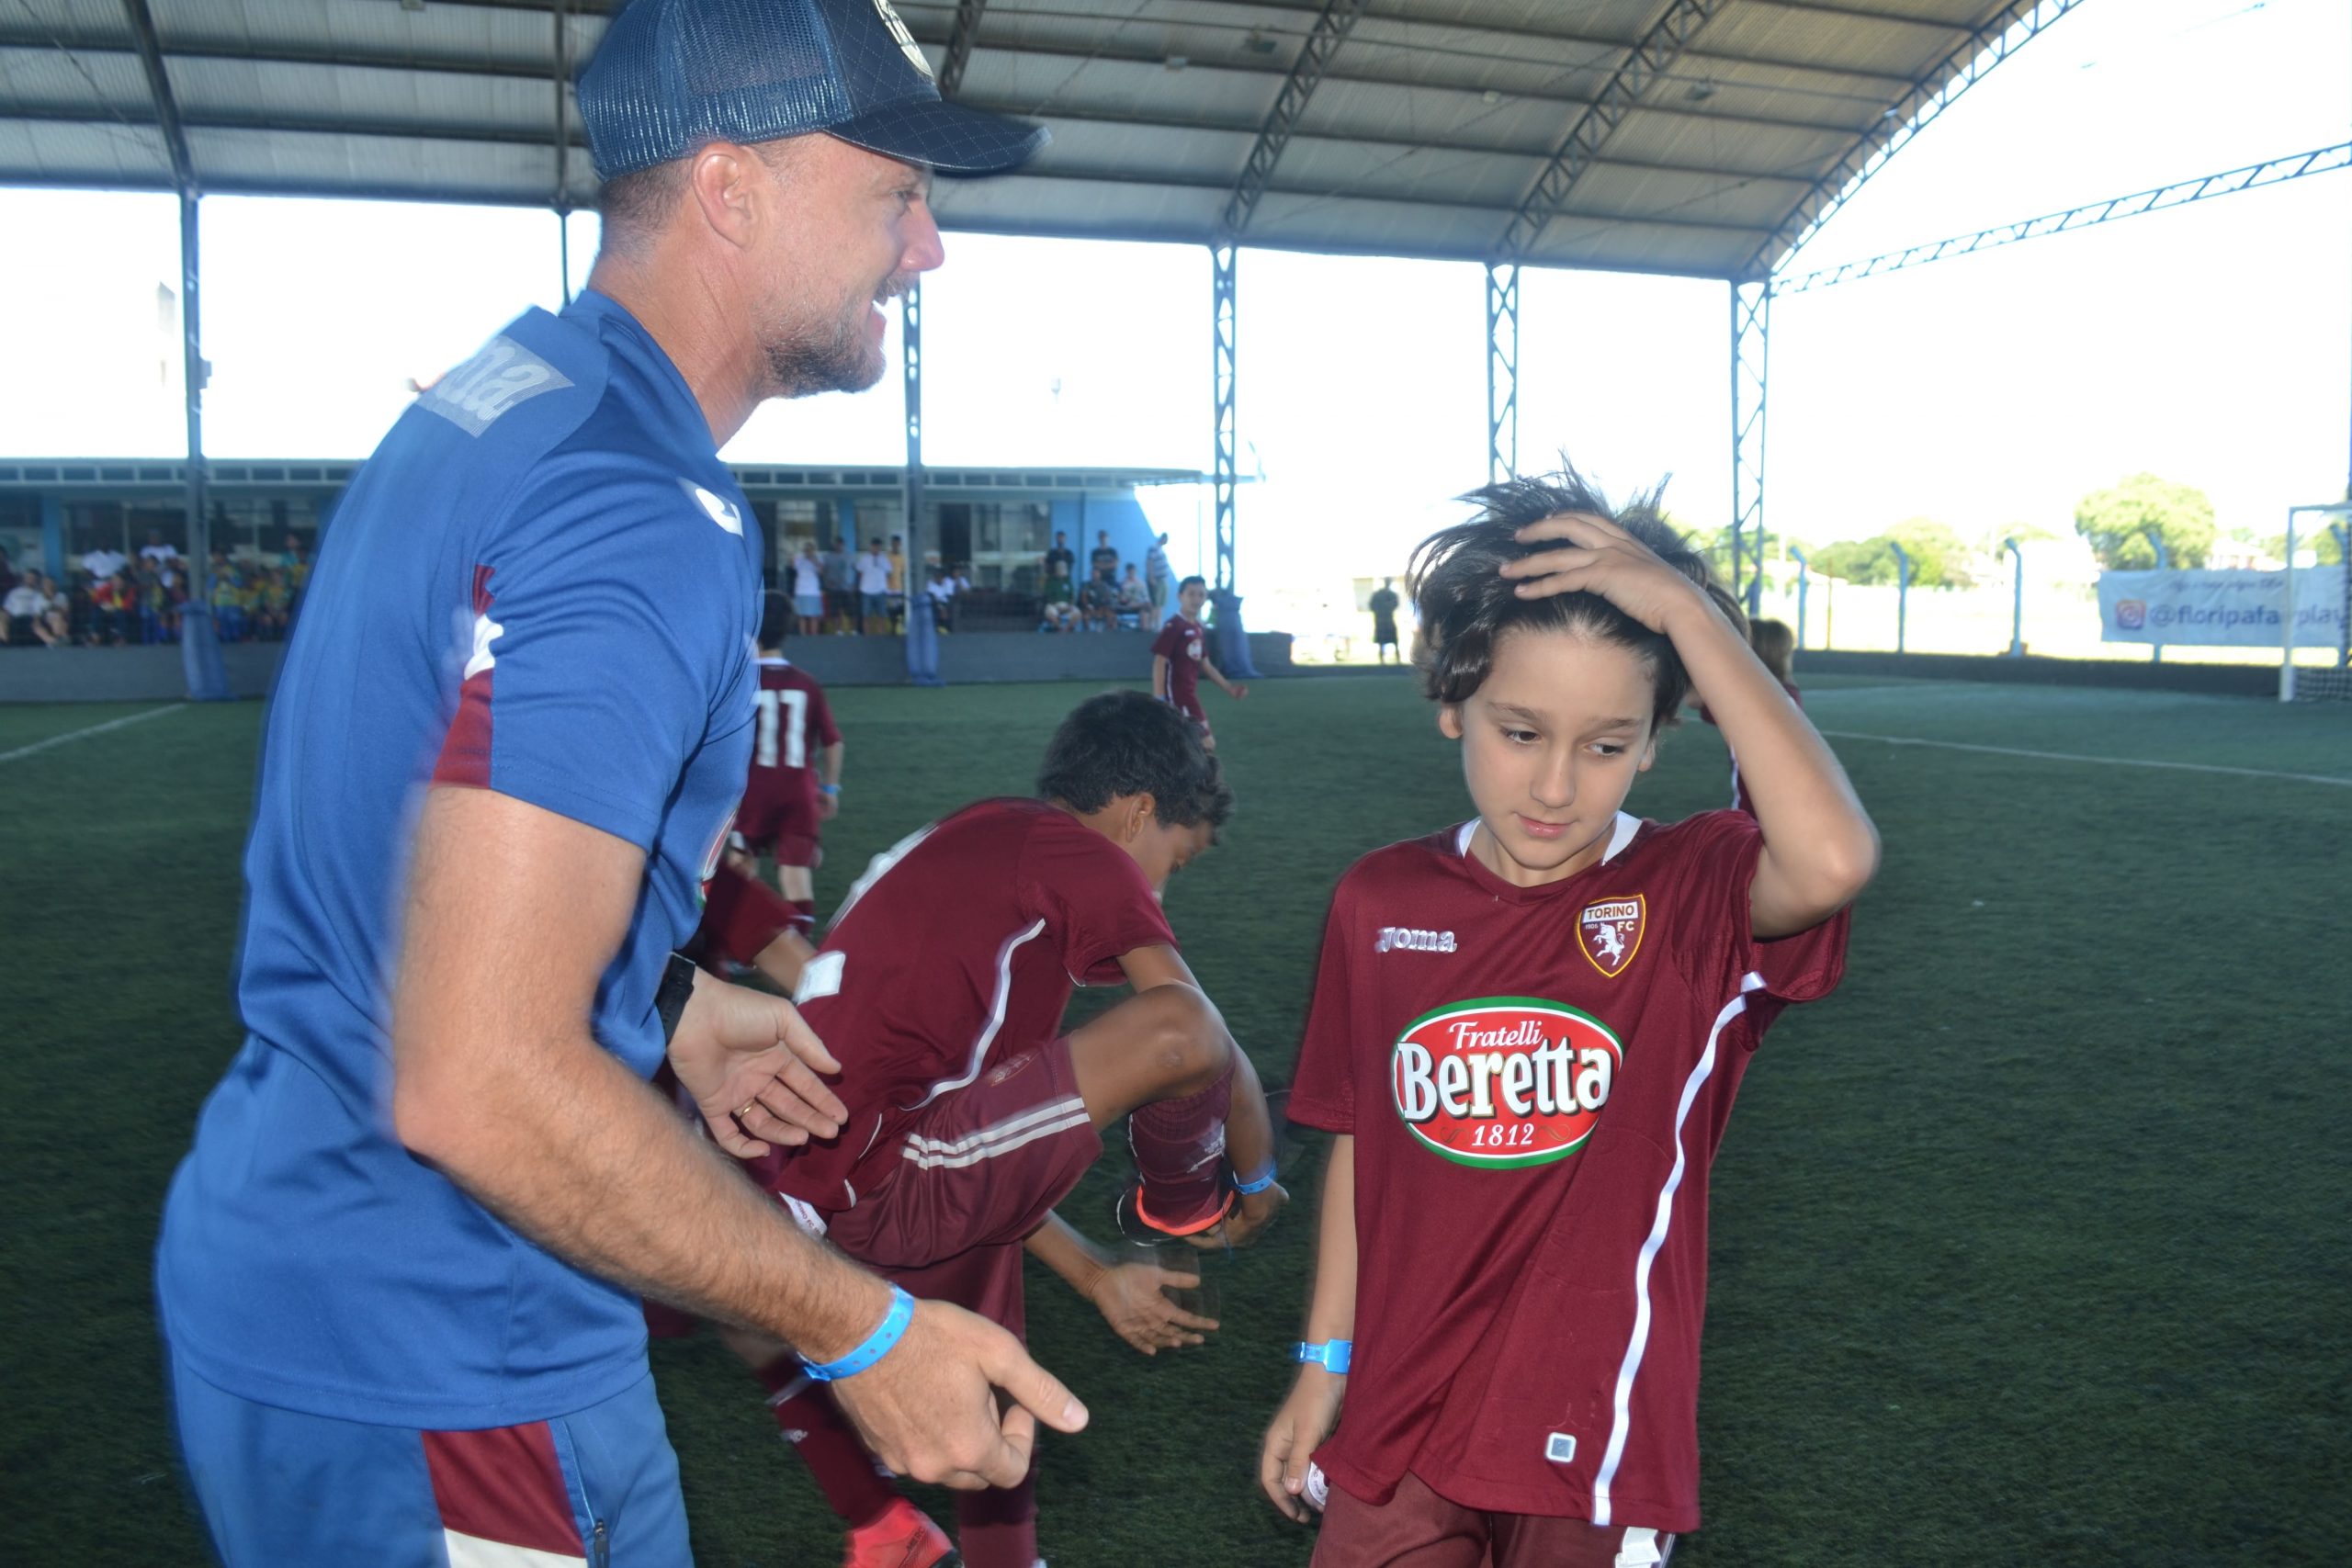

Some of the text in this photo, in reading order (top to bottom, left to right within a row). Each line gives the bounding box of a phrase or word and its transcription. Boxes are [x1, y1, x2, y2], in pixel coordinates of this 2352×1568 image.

[752, 689, 807, 768] 11
[1588, 905, 1634, 919] TORINO
[1617, 920, 1634, 931] FC
[1449, 1021, 1544, 1050] Fratelli
[1396, 1036, 1613, 1122] Beretta
[1472, 1122, 1534, 1146] 1812
